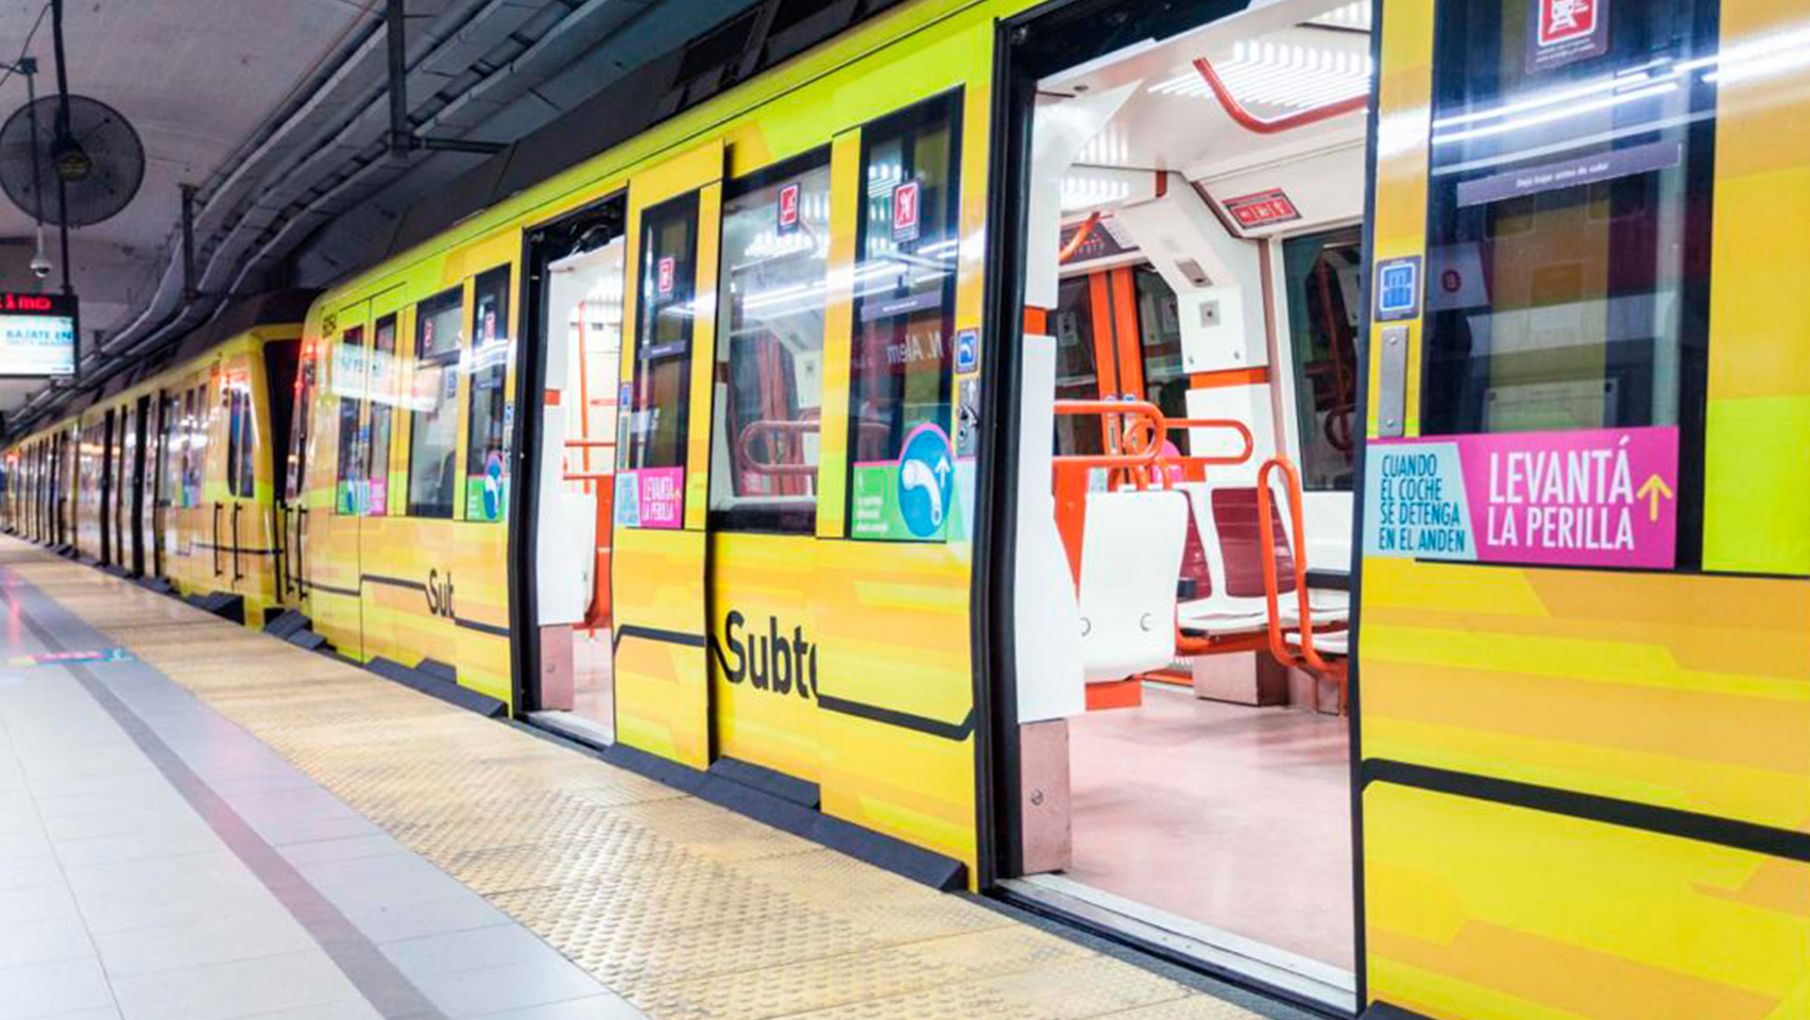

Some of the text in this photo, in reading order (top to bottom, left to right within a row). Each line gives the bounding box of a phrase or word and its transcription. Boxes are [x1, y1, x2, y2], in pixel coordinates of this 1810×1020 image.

[1382, 454, 1438, 478] CUANDO
[1489, 435, 1634, 505] LEVANTÁ
[1381, 477, 1442, 502] EL COCHE
[1380, 501, 1461, 527] SE DETENGA
[1379, 527, 1466, 553] EN EL ANDEN
[1487, 506, 1635, 551] LA PERILLA
